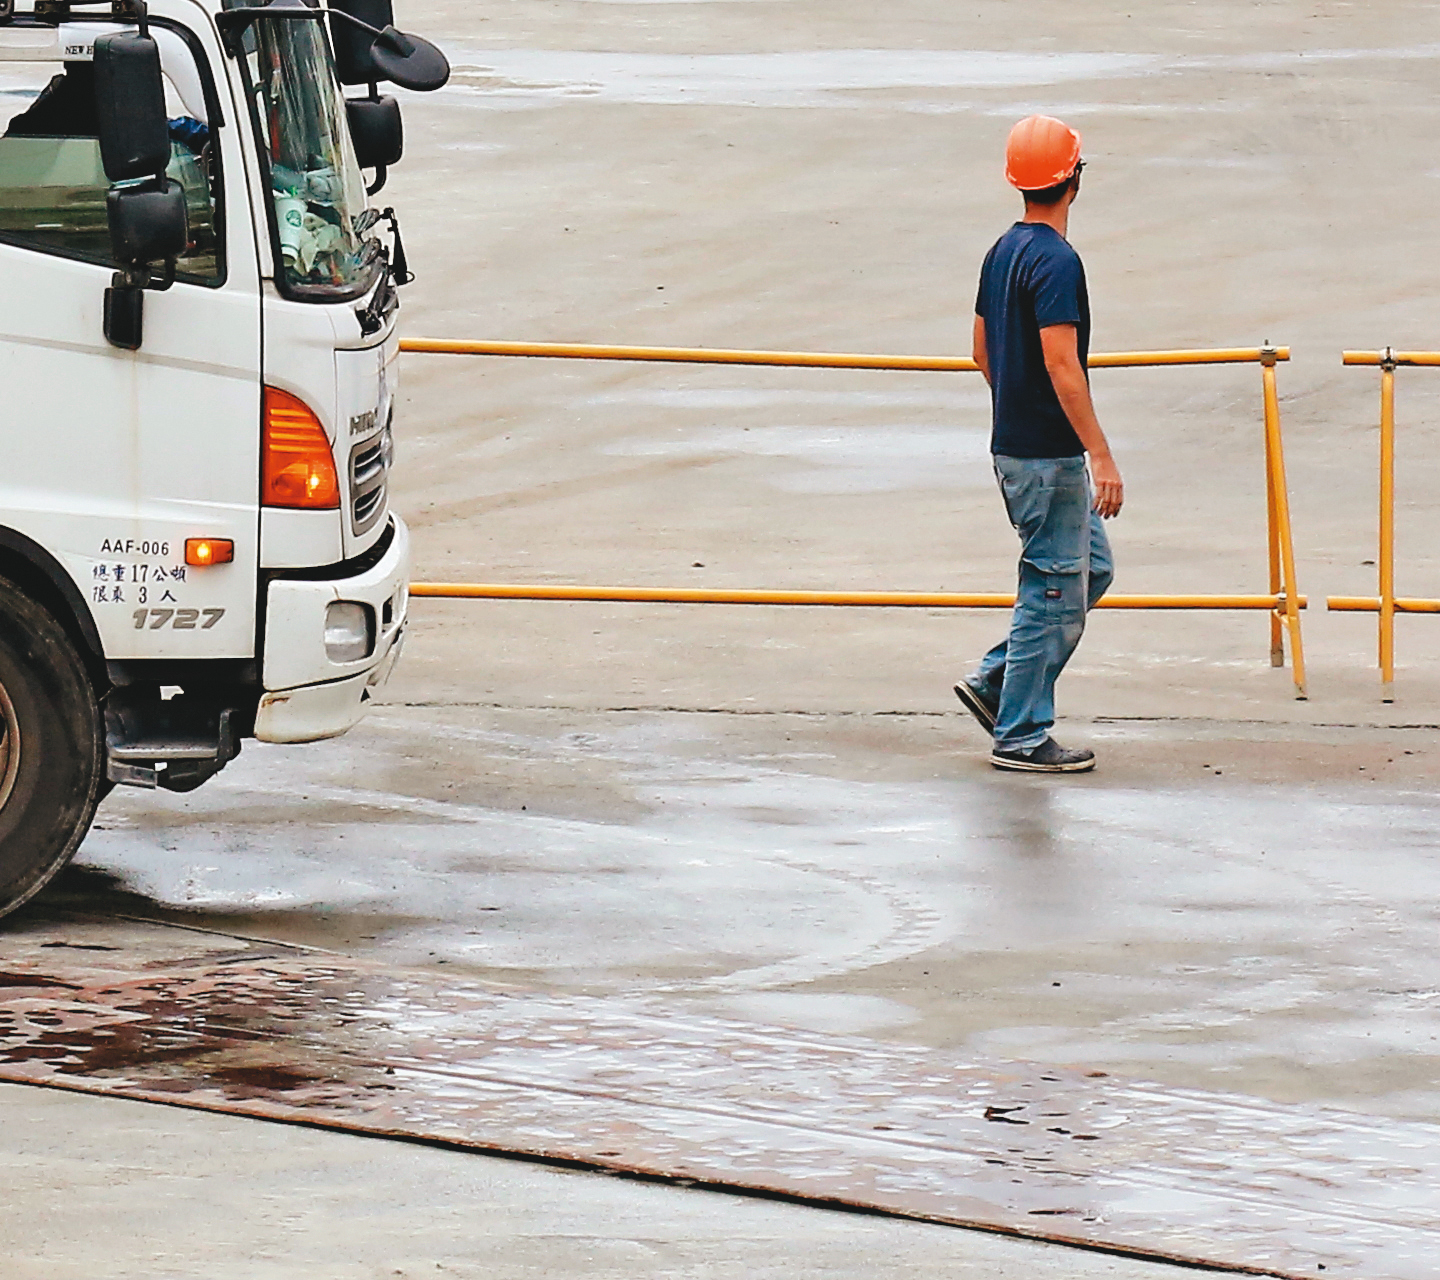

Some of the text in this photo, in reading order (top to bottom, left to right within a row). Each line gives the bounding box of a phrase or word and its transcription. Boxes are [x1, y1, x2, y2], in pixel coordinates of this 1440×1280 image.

[100, 538, 169, 556] AAF-006
[138, 586, 148, 604] 3
[160, 589, 178, 603] 人
[133, 608, 226, 630] 1727
